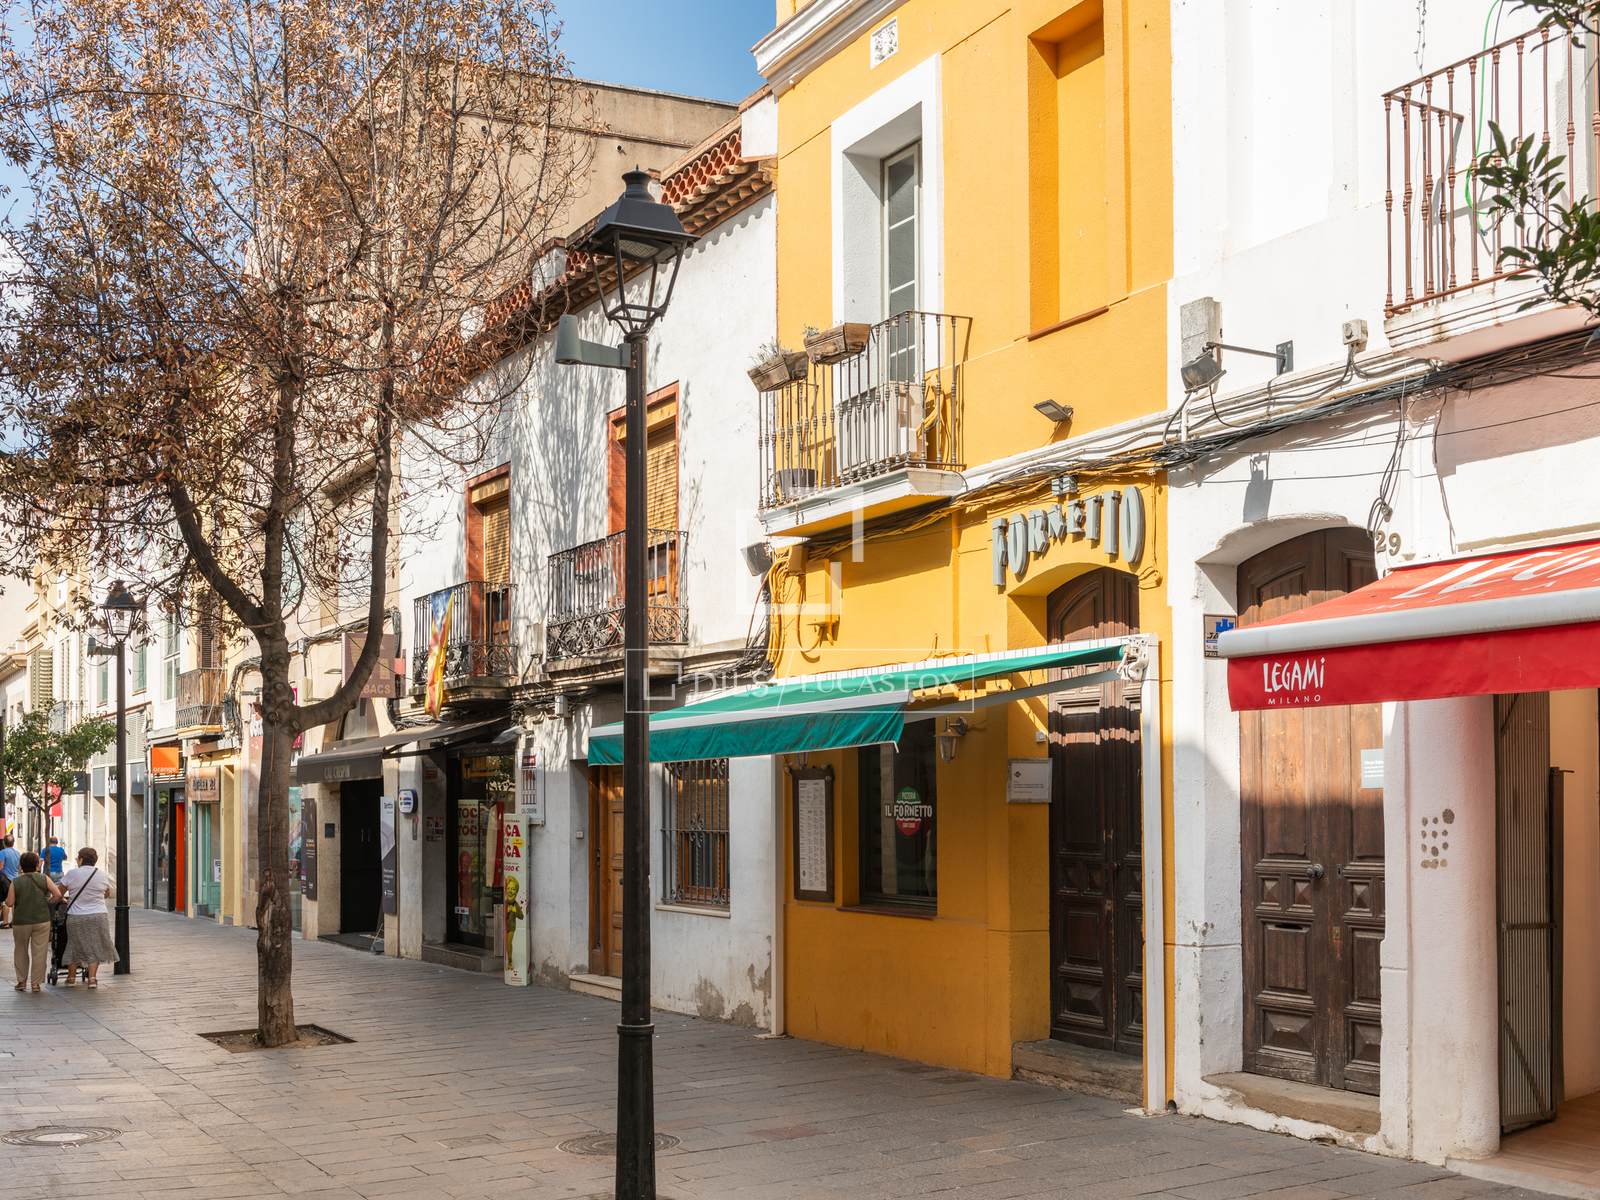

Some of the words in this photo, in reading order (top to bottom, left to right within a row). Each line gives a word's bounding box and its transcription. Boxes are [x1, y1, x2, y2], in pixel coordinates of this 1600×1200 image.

[992, 486, 1146, 586] FORNETTO
[1375, 530, 1402, 557] 29
[1268, 694, 1321, 705] MILANO
[152, 767, 178, 775] orange
[885, 805, 892, 817] IL
[893, 805, 933, 818] FORNETTO
